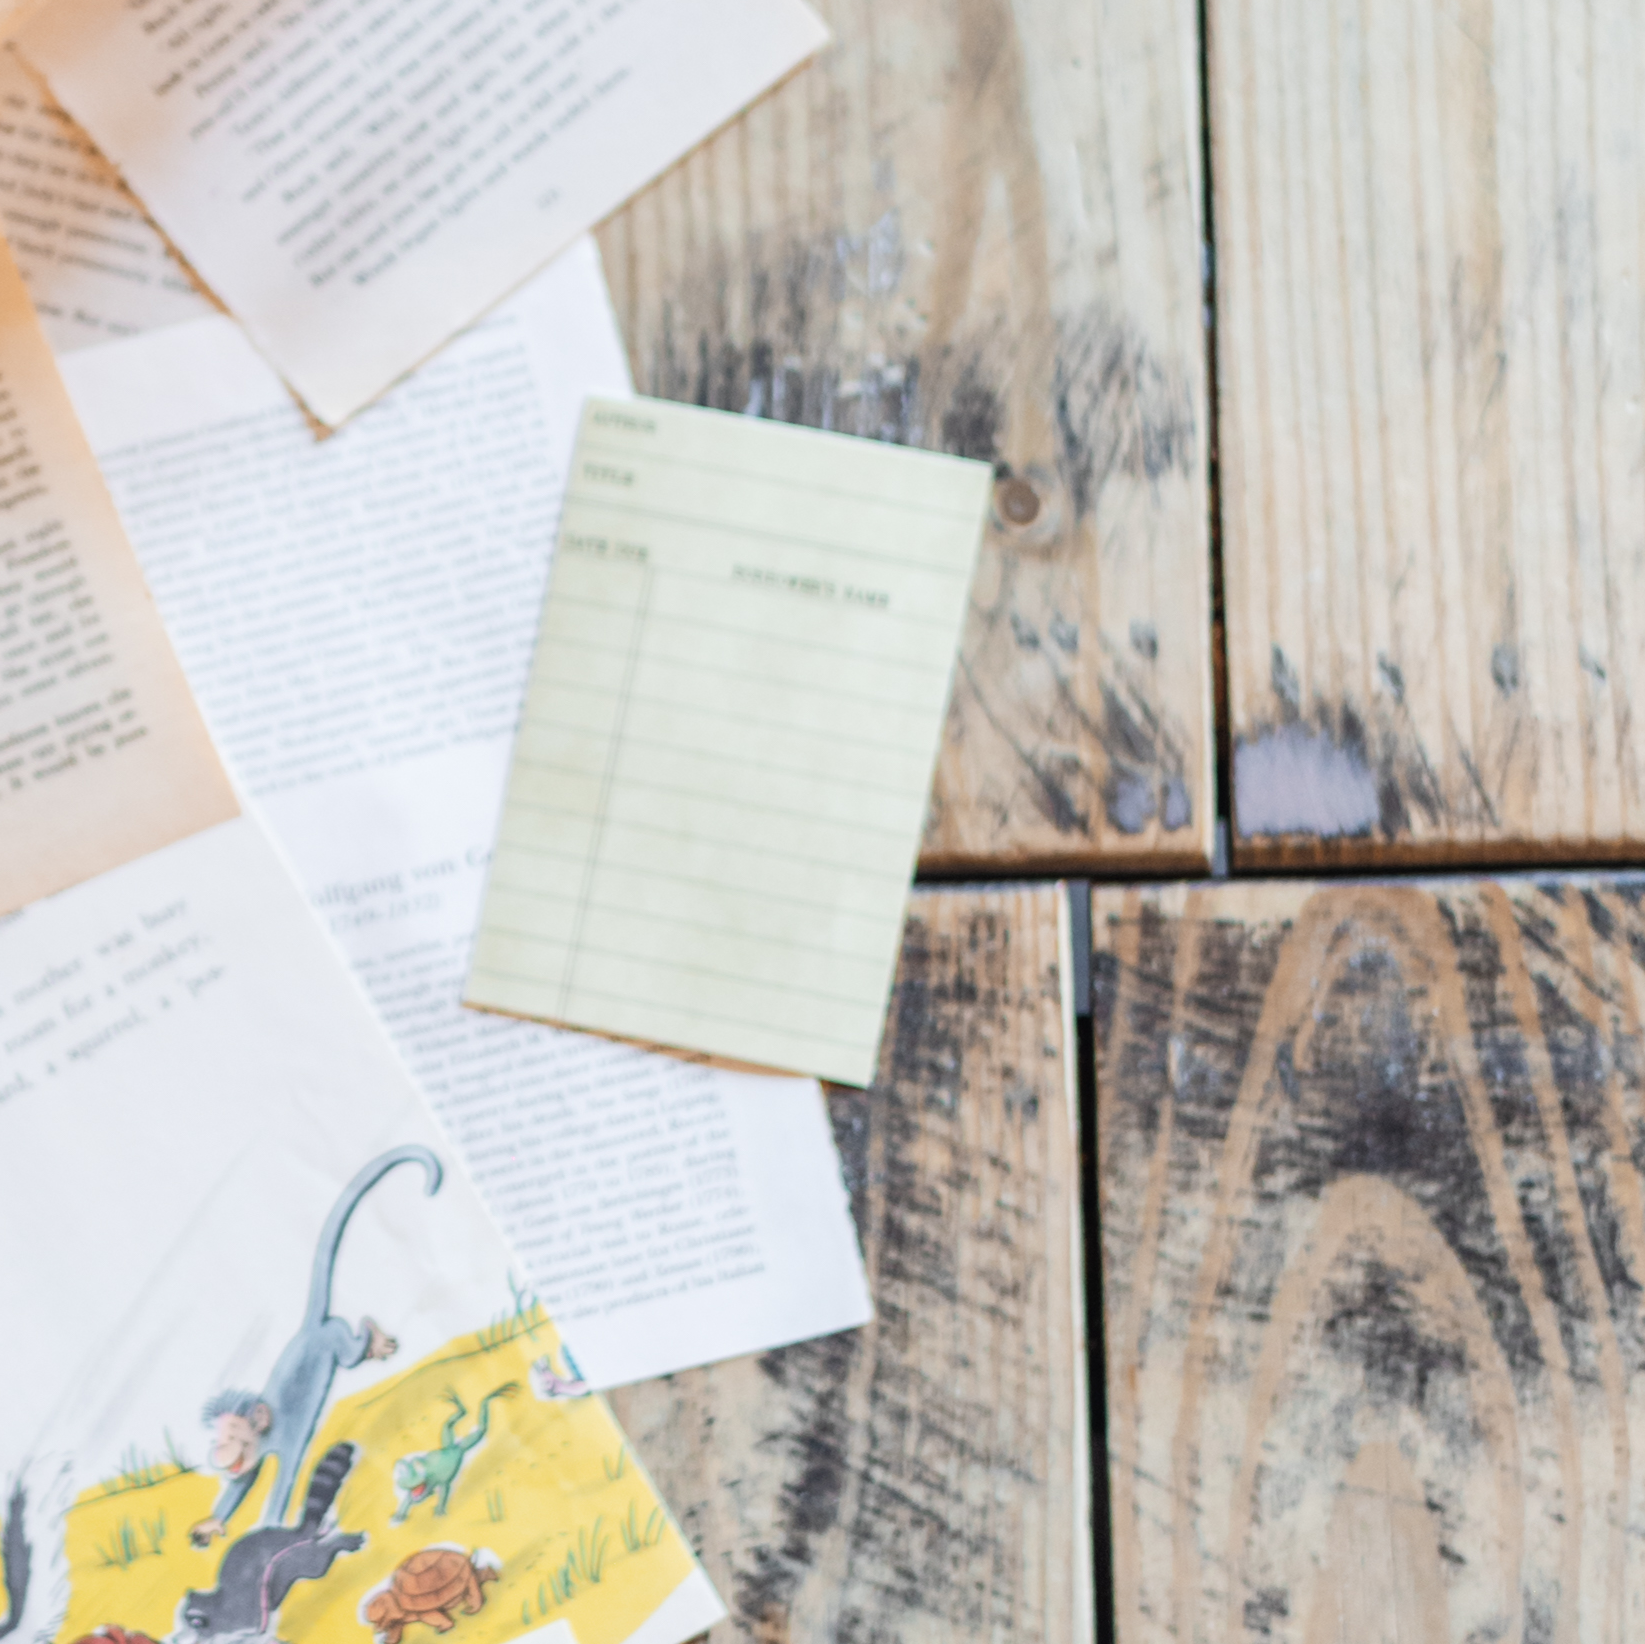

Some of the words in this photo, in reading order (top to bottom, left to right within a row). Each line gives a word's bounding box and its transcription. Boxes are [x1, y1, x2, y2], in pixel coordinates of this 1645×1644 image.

[11, 956, 84, 1006] mother
[93, 928, 136, 958] was
[137, 898, 187, 932] busy
